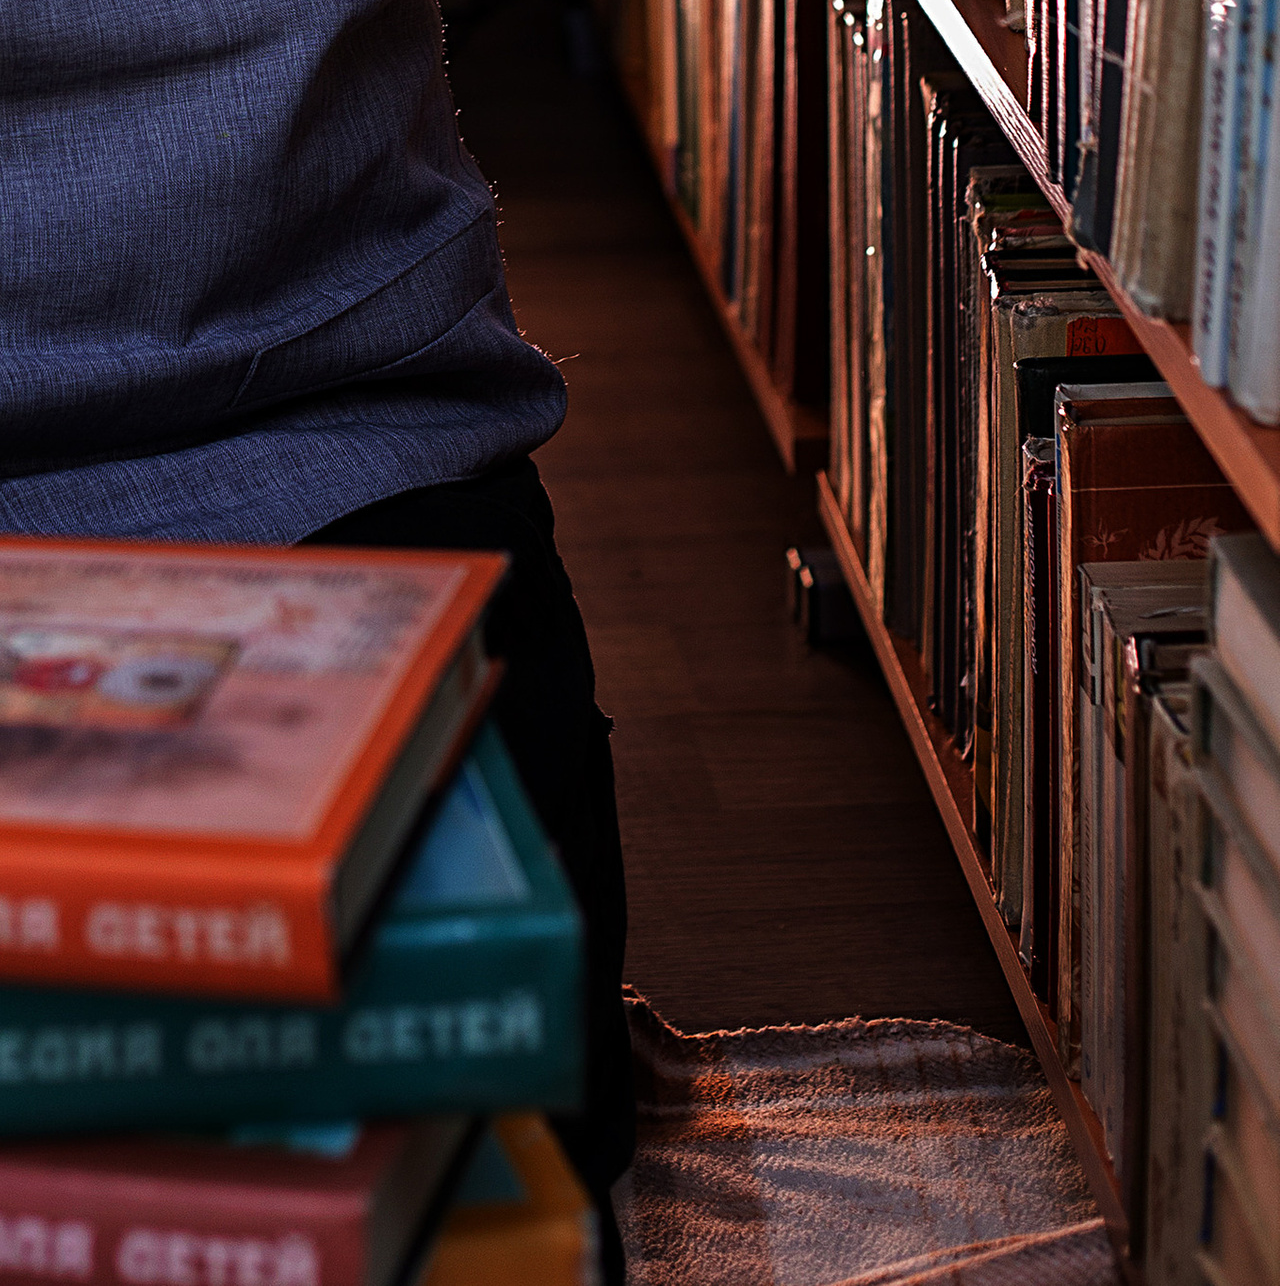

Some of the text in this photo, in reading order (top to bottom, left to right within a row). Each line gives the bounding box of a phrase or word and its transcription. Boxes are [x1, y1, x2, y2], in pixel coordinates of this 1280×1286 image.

[86, 899, 291, 967] ДЕТЕЙ
[187, 1015, 317, 1072] ДЛЯ
[345, 993, 543, 1061] ДЕТЕЙ
[116, 1226, 318, 1286] ДЕТЕЙ
